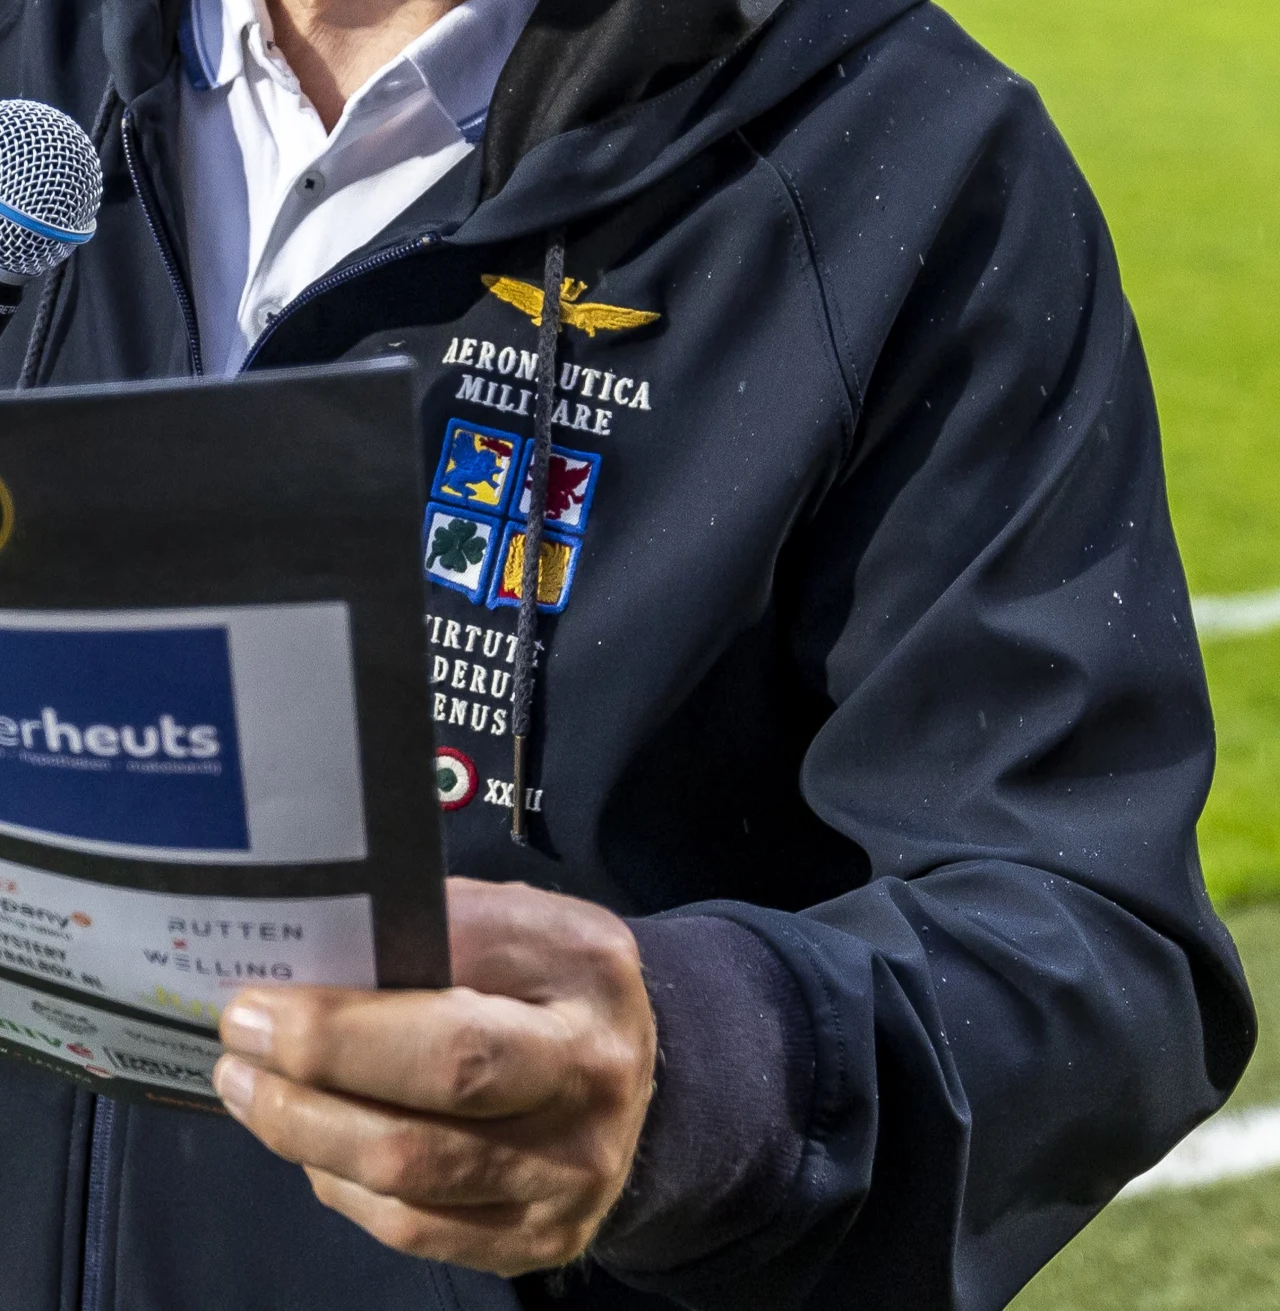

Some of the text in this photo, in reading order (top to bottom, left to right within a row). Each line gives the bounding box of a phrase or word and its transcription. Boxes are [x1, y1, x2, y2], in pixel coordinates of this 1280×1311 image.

[442, 337, 652, 411] AERONUTICA
[455, 373, 613, 436] MILIARE
[425, 614, 545, 669] IRTUT
[432, 691, 508, 737] ENUS
[483, 778, 544, 813] XXII
[168, 915, 304, 940] RUTTEN
[143, 947, 294, 981] WELLING
